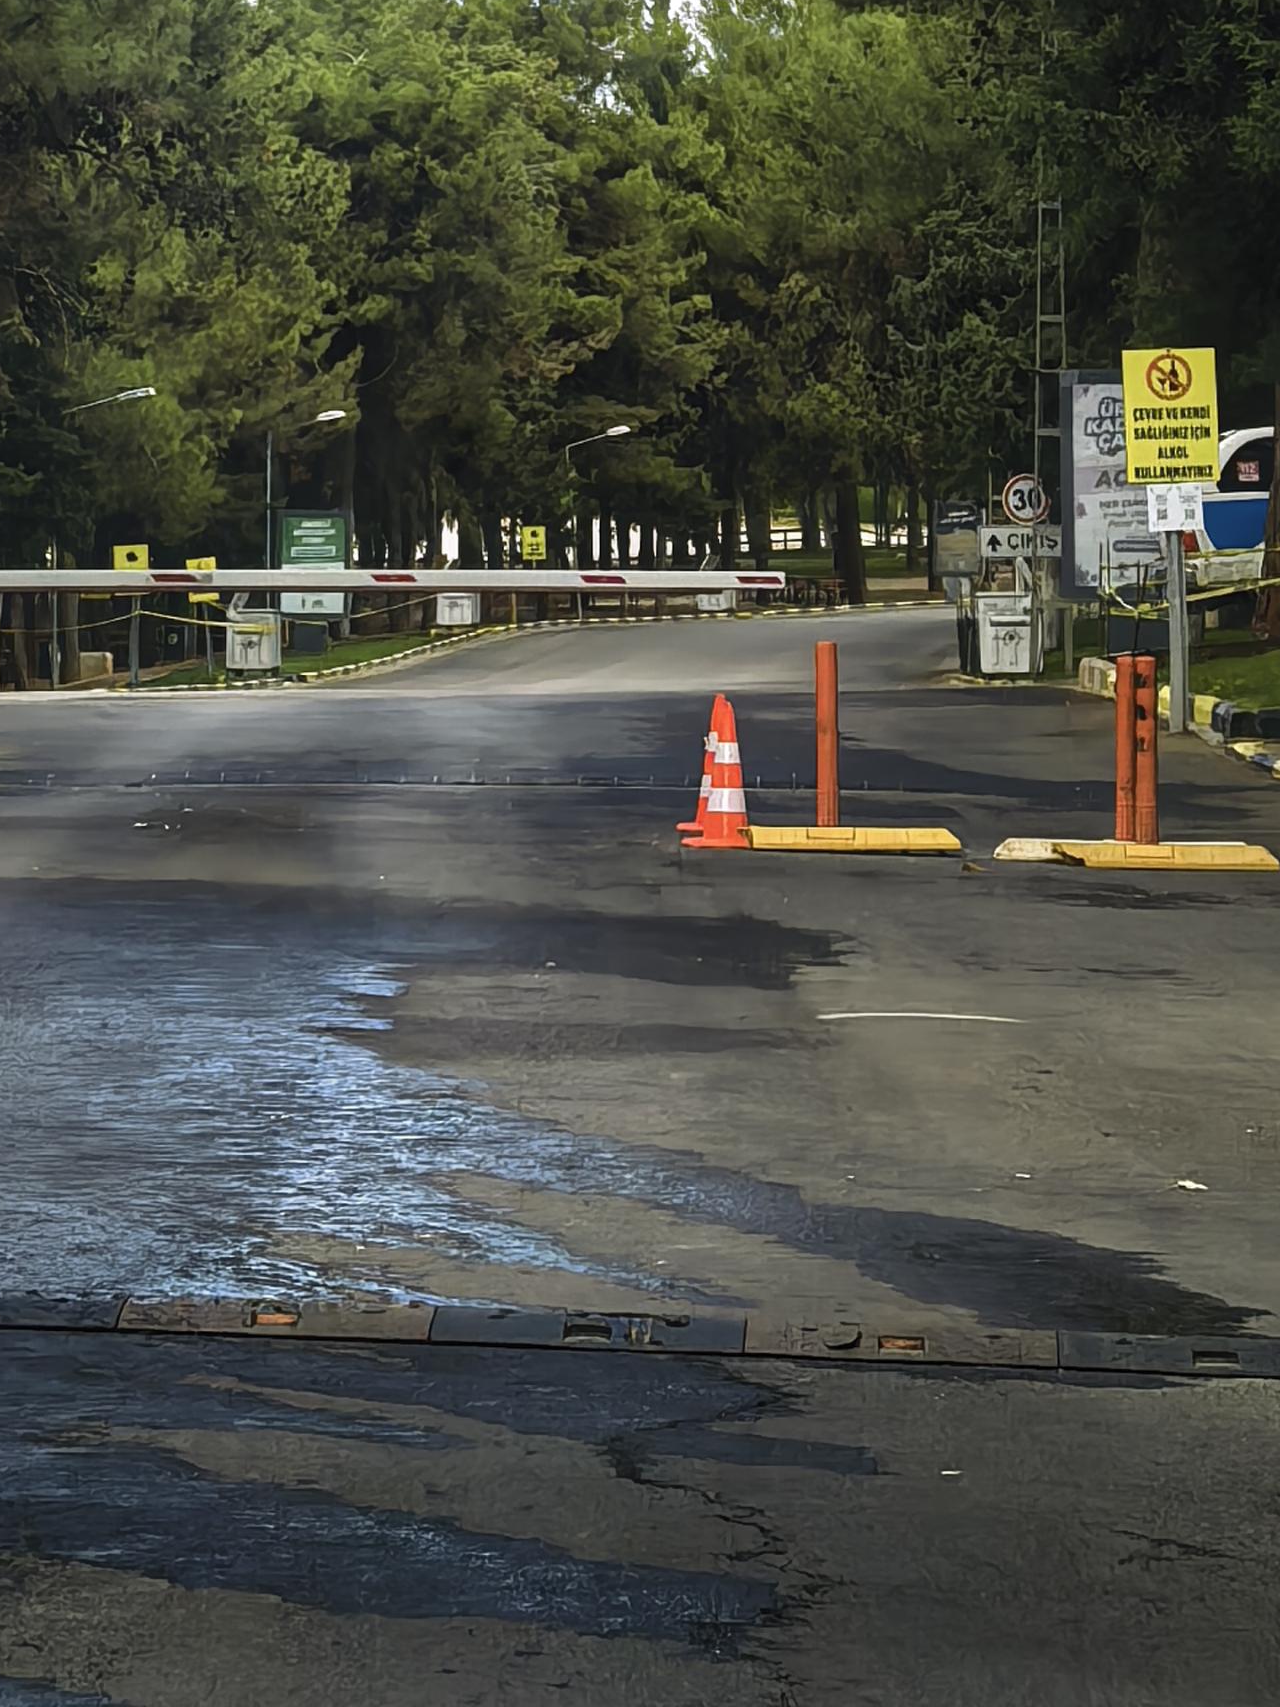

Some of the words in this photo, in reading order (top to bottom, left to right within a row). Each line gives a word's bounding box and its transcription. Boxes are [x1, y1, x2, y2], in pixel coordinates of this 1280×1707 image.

[1133, 407, 1164, 422] ÇEVRE
[1180, 405, 1210, 419] KENDİ
[1190, 423, 1211, 442] İÇİN
[1158, 445, 1189, 459] ALKOL
[1134, 465, 1213, 479] KULLANMAYINIZ
[1012, 488, 1040, 511] 30
